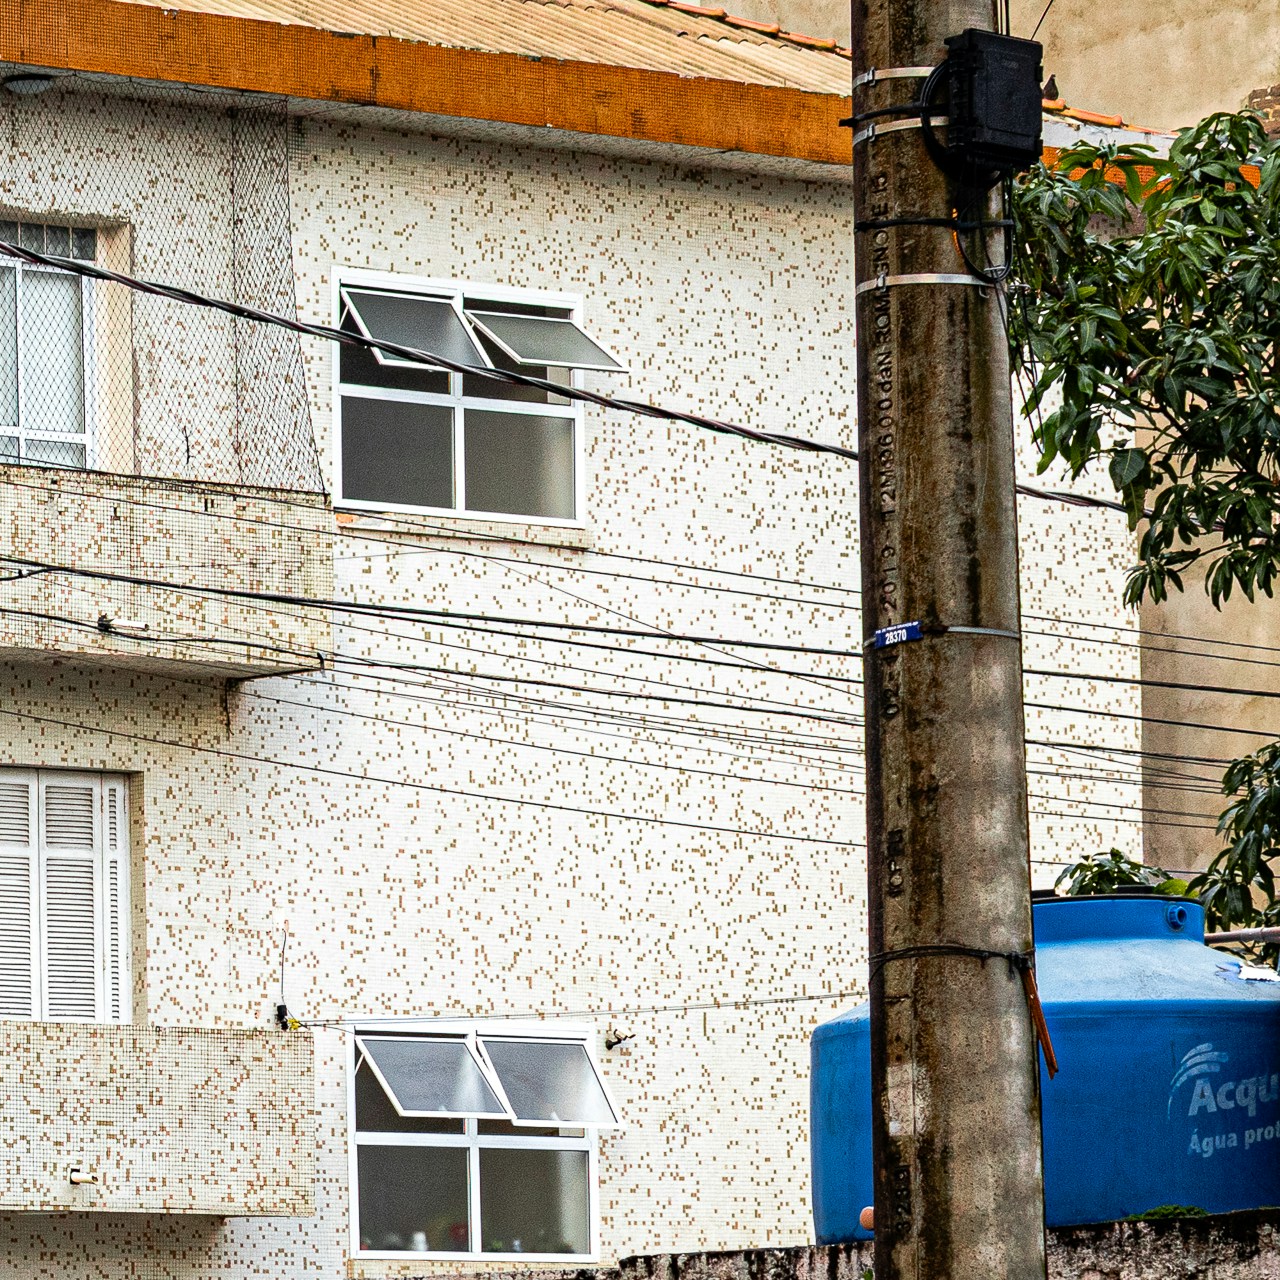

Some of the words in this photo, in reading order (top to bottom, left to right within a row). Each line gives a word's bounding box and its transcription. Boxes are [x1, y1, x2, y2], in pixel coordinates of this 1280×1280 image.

[871, 203, 891, 344] ROMGNOE
[885, 629, 907, 645] 28370
[1188, 1073, 1280, 1117] Acqu
[1188, 1129, 1238, 1158] Água
